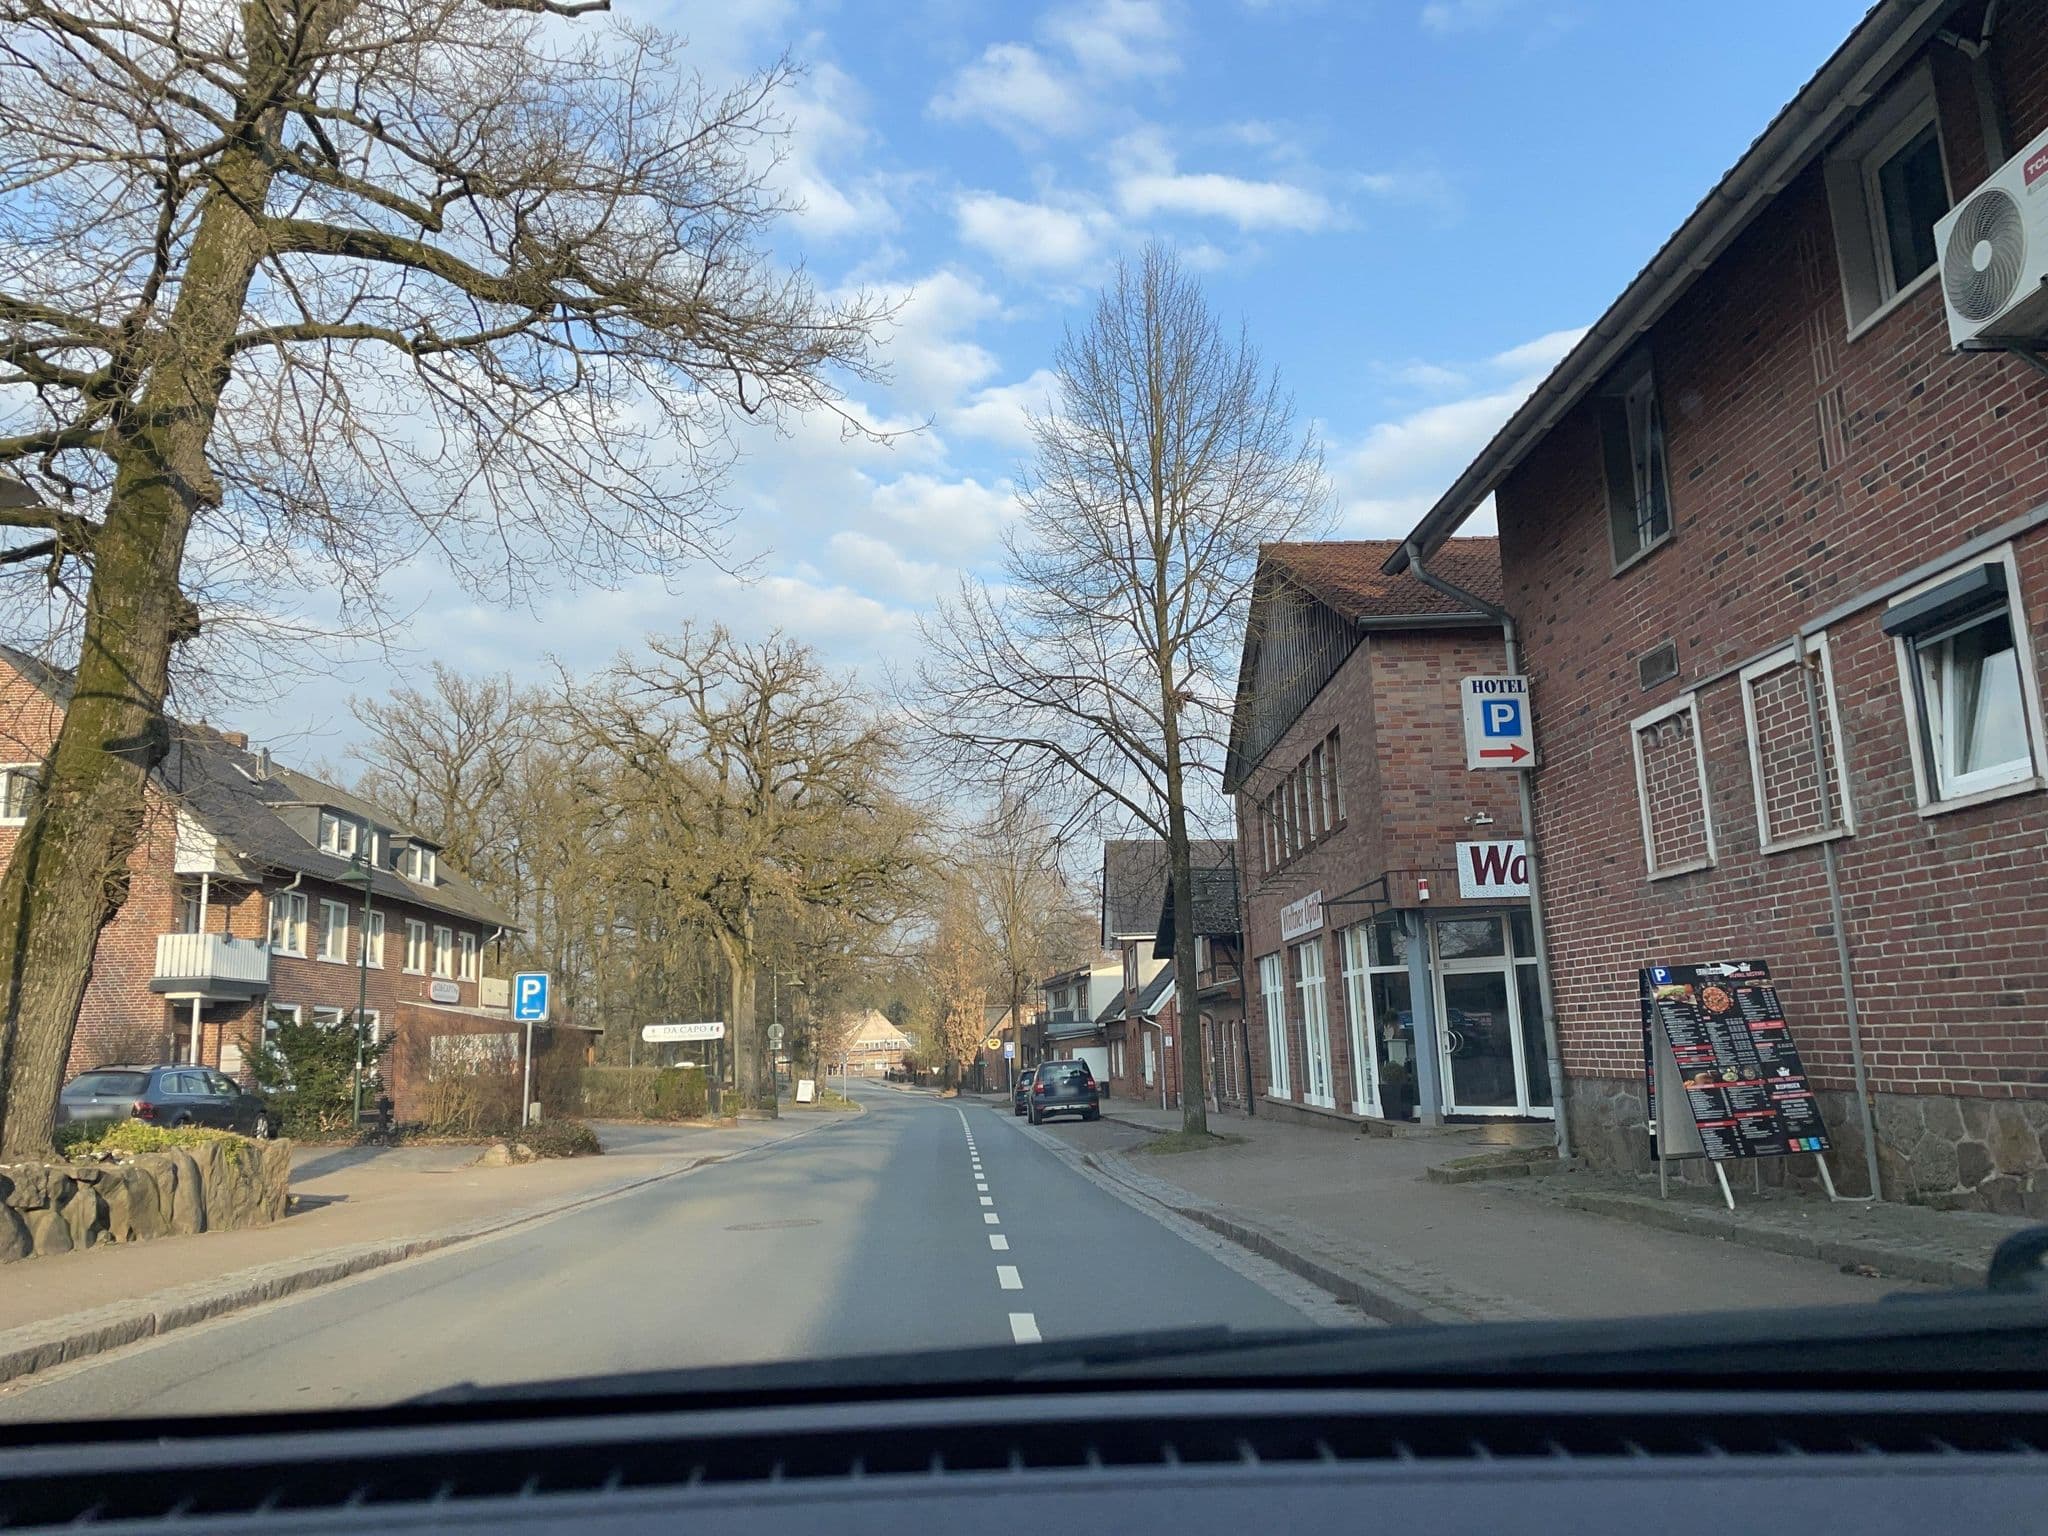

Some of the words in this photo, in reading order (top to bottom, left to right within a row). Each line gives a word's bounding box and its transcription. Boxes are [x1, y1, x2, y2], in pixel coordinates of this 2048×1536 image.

[2027, 154, 2048, 175] TCL
[1472, 679, 1526, 694] HOTEL
[1490, 703, 1515, 733] P
[1654, 968, 1666, 982] P
[522, 979, 541, 1004] P
[663, 1026, 678, 1034] DA
[680, 1025, 707, 1033] CAPO
